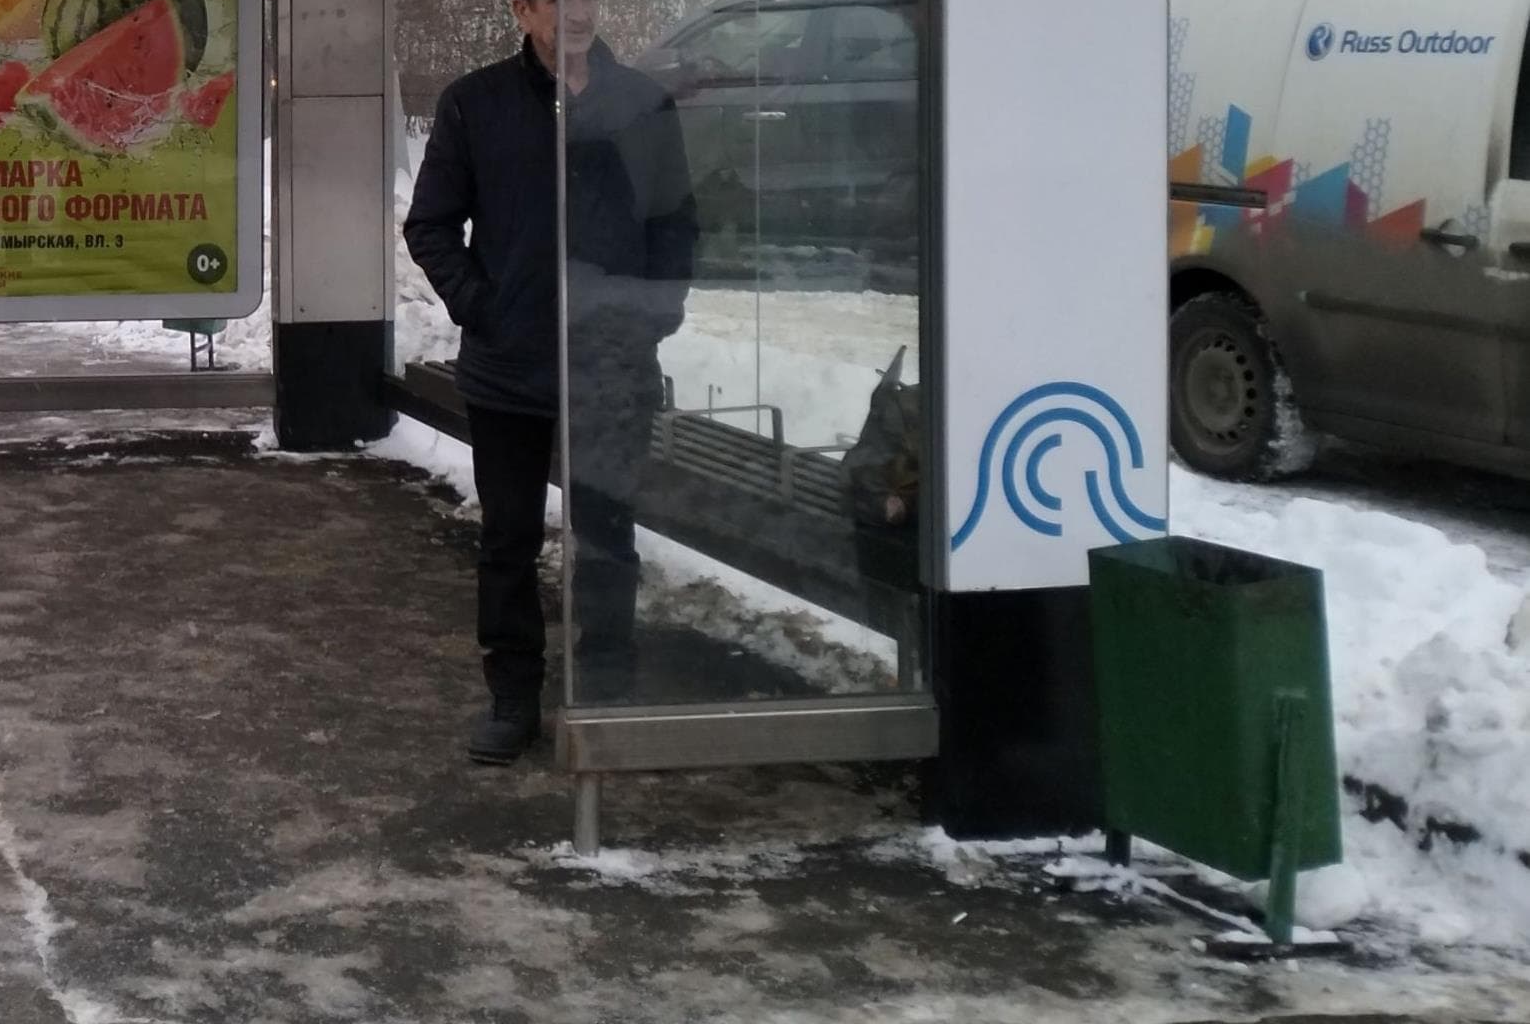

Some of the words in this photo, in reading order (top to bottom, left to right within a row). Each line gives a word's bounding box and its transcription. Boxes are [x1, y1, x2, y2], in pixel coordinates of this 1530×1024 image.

[1339, 29, 1394, 54] Russ
[1397, 29, 1496, 54] Outdoor
[64, 192, 208, 221] ФОРМАТА
[84, 234, 110, 249] ВЛ.
[115, 234, 124, 248] 3
[196, 254, 221, 272] 0+
